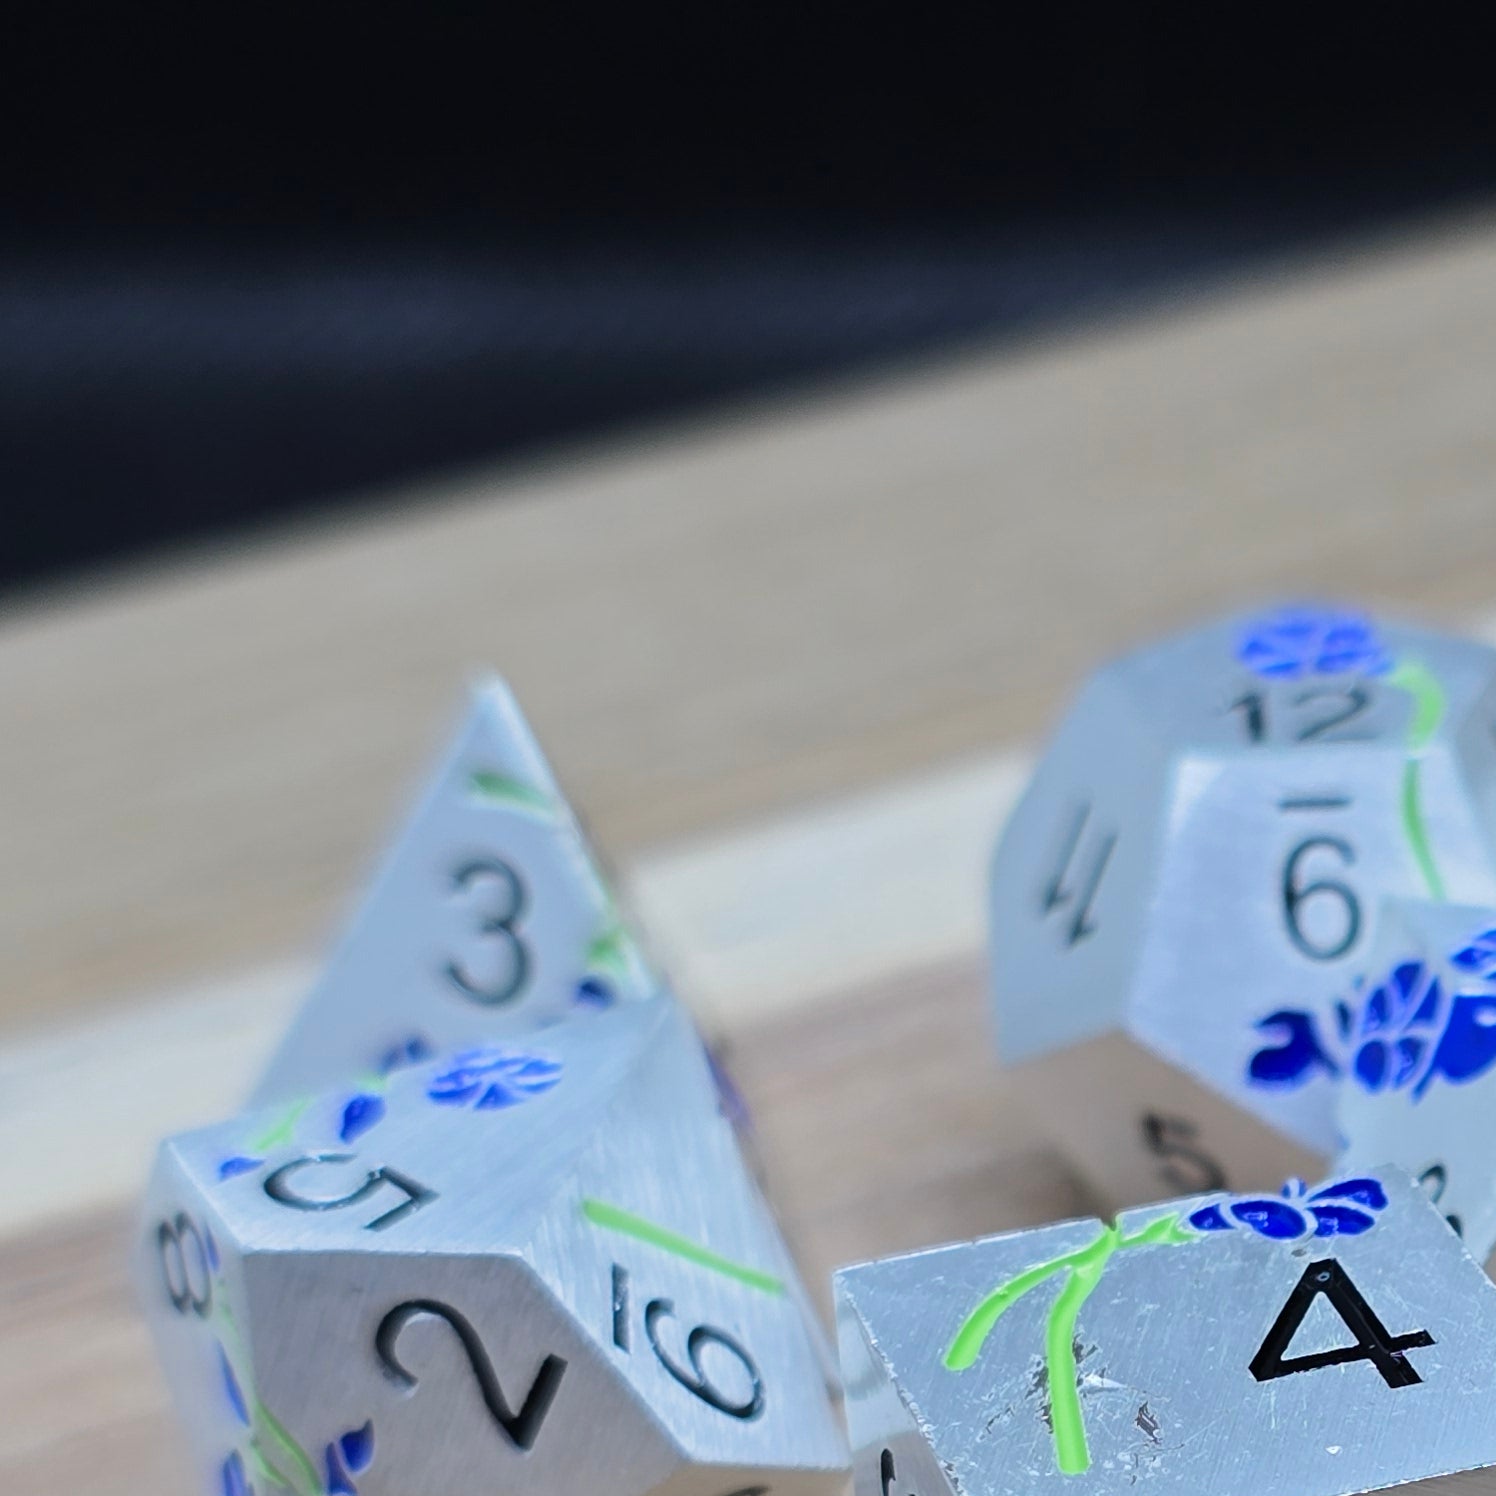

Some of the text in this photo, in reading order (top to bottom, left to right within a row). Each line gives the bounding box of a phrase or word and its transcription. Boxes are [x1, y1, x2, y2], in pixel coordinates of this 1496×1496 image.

[1232, 683, 1379, 744] 12
[446, 857, 534, 1006] 3
[1040, 803, 1118, 951] 11
[264, 1153, 440, 1232] 5
[1141, 1107, 1227, 1195] 5
[156, 1210, 212, 1320] 8
[1248, 1256, 1438, 1390] 4
[375, 1299, 568, 1451] 2
